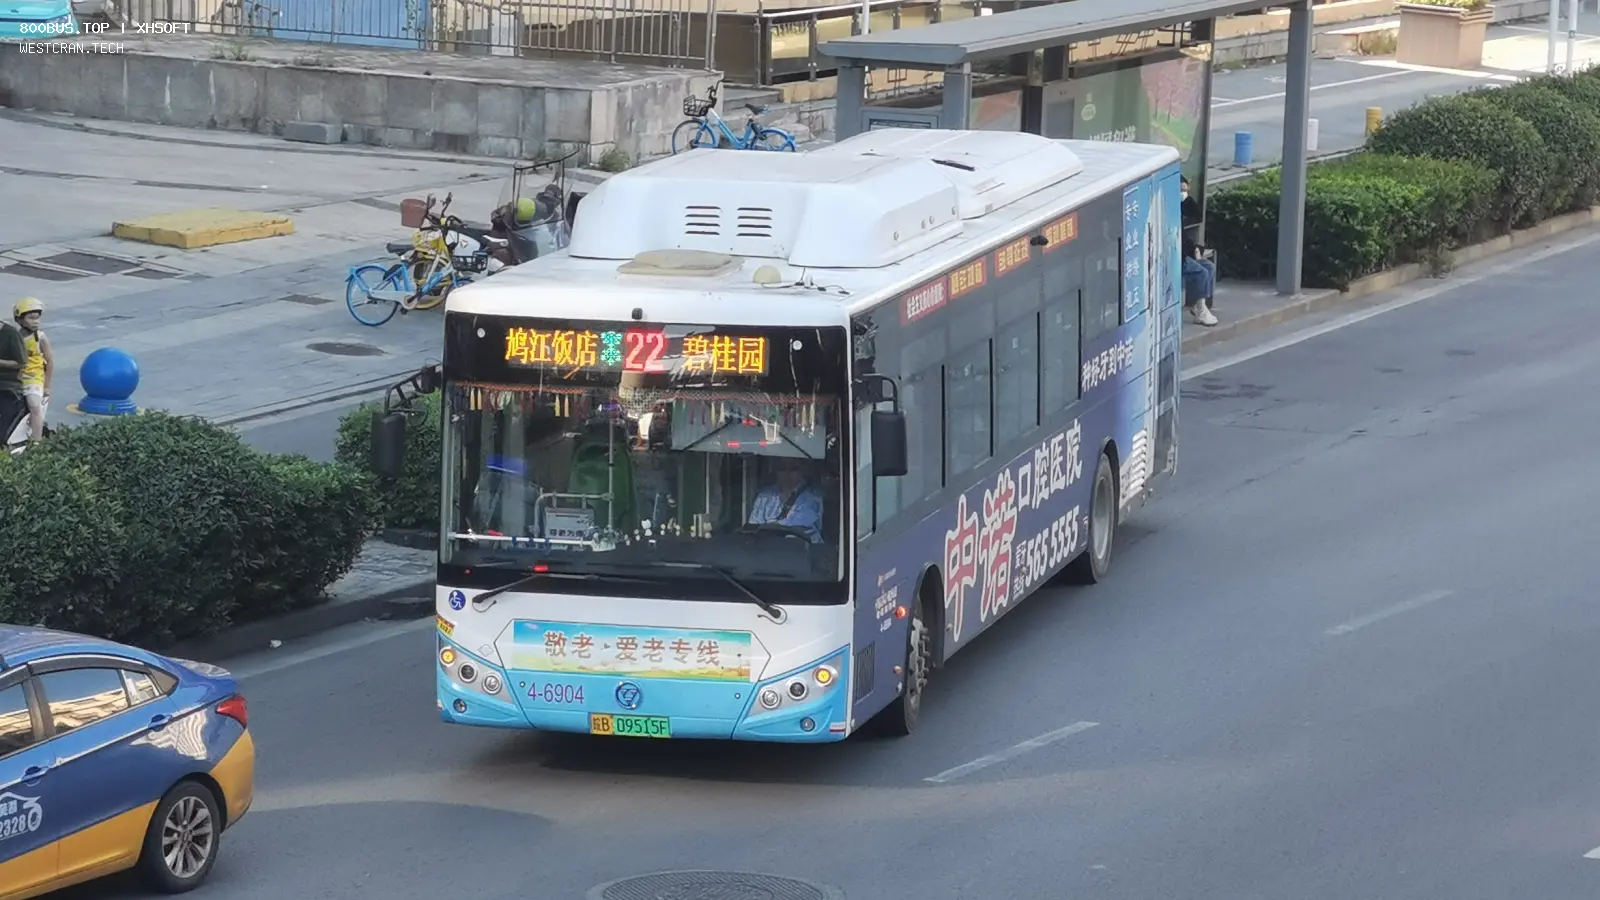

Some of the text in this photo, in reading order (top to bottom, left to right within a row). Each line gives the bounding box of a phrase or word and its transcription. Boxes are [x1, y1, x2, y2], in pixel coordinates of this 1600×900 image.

[504, 327, 765, 374] 鸠江饭店 22 碧桂园
[1018, 418, 1083, 512] 口腔医院
[1025, 536, 1048, 588] 565
[1049, 504, 1080, 569] 5555
[527, 682, 585, 704] 4-6904
[616, 717, 667, 735] 09515F
